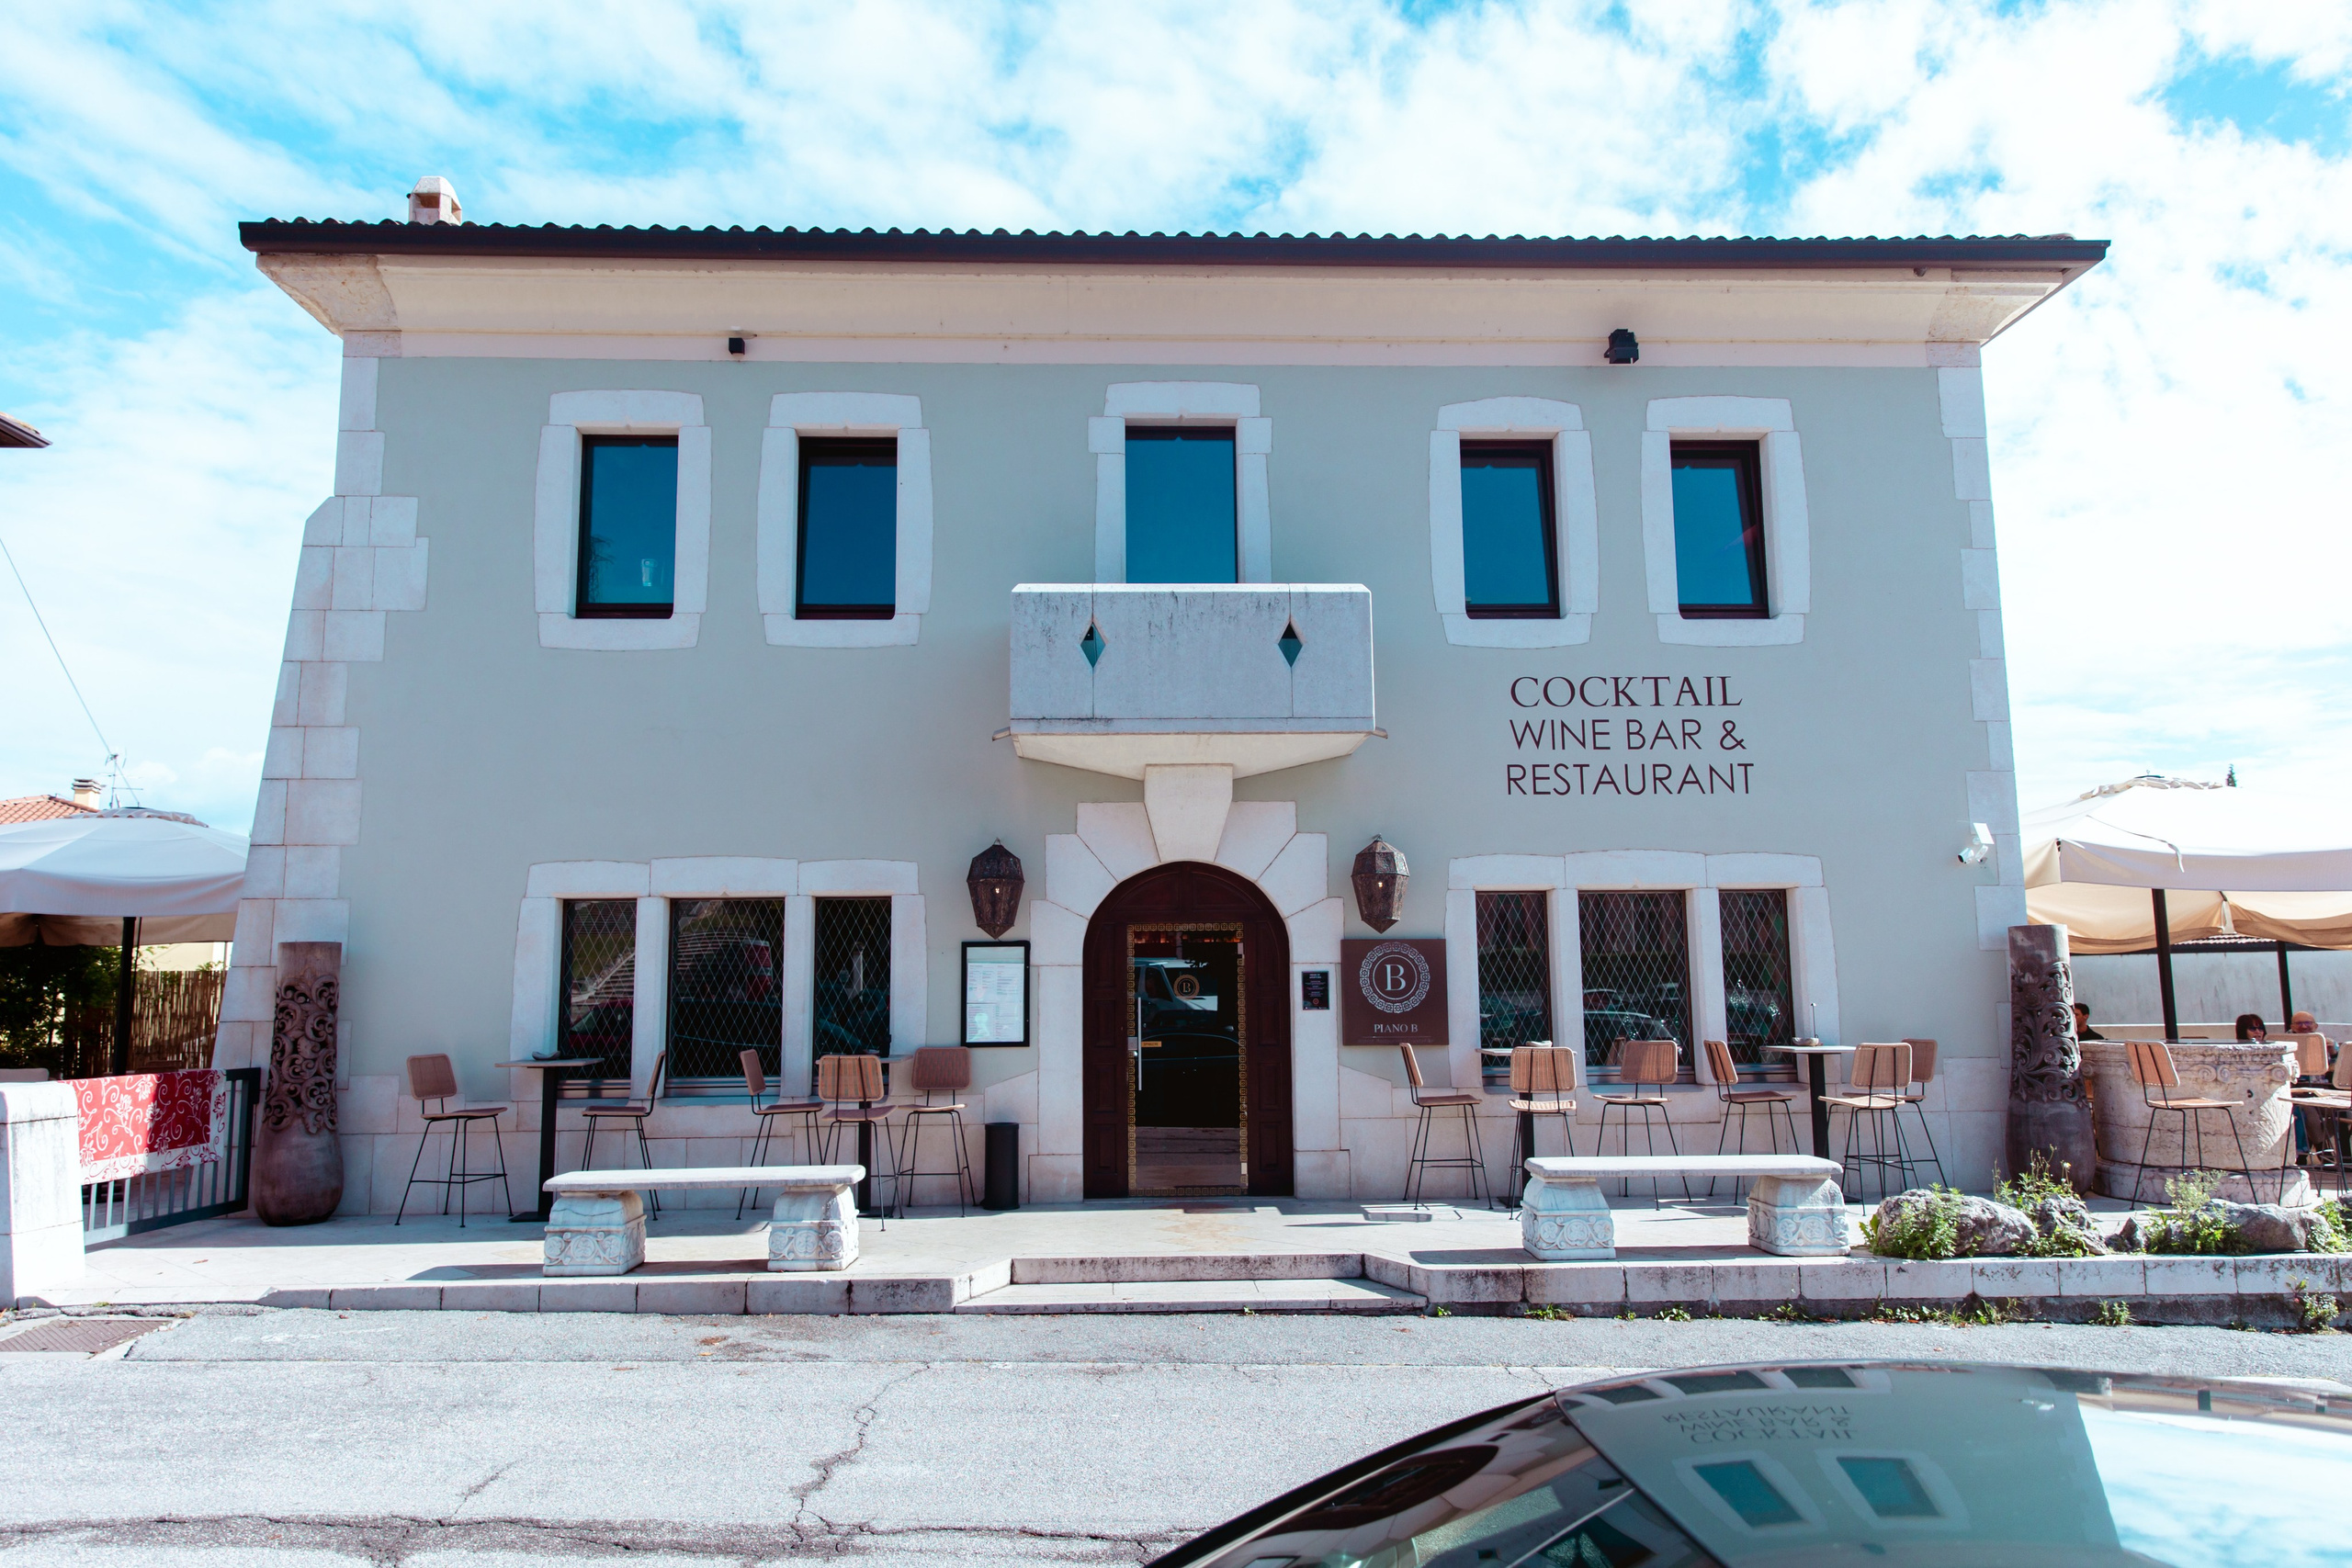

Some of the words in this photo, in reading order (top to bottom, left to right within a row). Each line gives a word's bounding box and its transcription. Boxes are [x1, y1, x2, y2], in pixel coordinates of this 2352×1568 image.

[1510, 675, 1743, 708] COCKTAIL
[1509, 718, 1611, 750] WINE
[1625, 718, 1702, 750] BAR
[1719, 719, 1747, 750] &
[1506, 762, 1755, 796] RESTAURANT
[1385, 964, 1407, 991] B
[1374, 1023, 1408, 1033] PIANO
[1410, 1023, 1419, 1033] B
